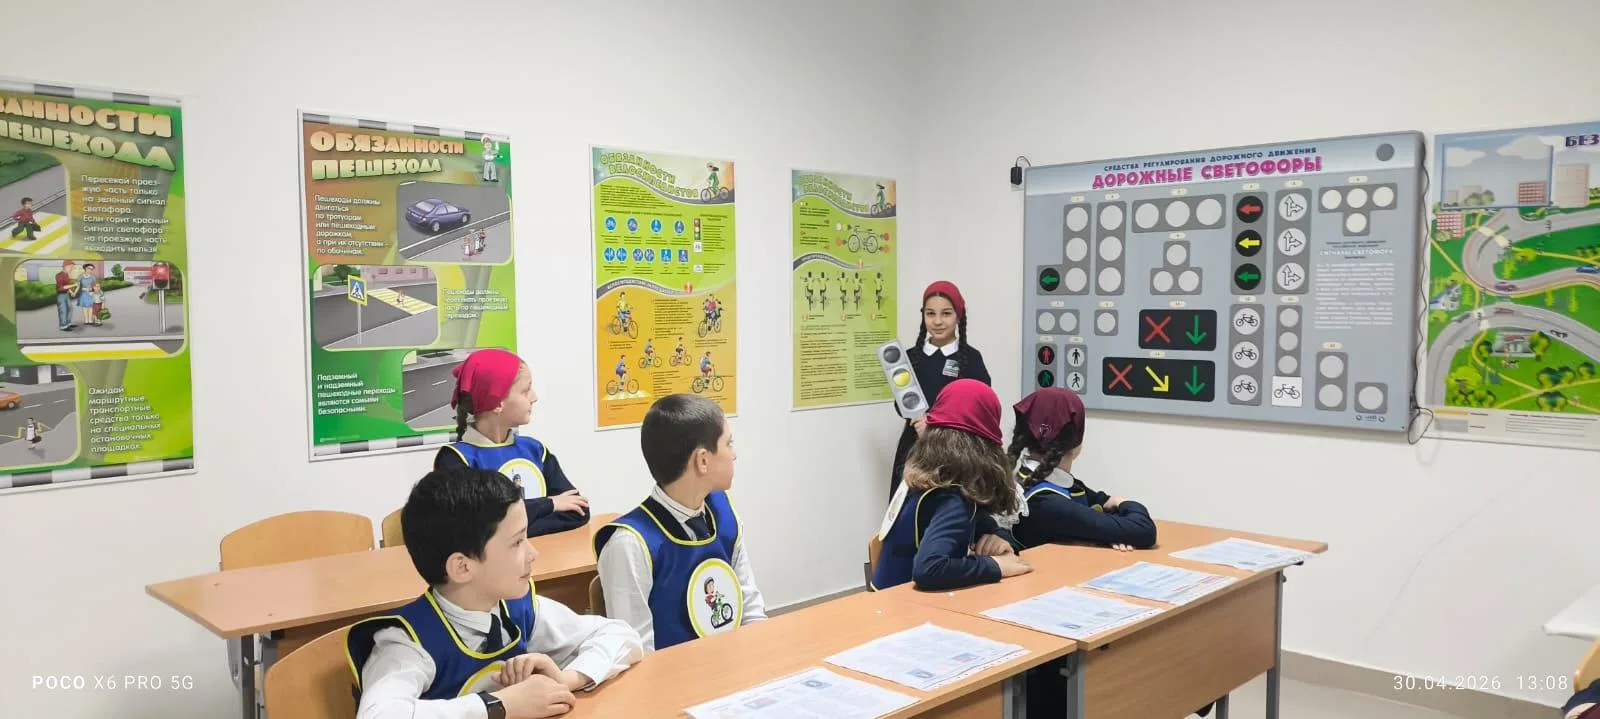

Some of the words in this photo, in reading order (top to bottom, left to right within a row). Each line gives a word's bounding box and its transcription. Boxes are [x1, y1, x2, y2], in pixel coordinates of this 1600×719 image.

[310, 131, 464, 154] ОБЯЗАННОСТИ
[1565, 134, 1600, 147] БЕЗ
[1104, 163, 1139, 171] СРЕДСТВА
[1143, 157, 1206, 168] РЕГУЛИРОВАНИЯ
[1210, 151, 1263, 162] ДОРОЖНОГО
[1268, 147, 1317, 157] ДВИЖЕНИЯ
[312, 158, 442, 180] ПЕШЕХОДА
[1092, 167, 1192, 189] ДОРОЖНЫЕ
[1201, 156, 1322, 180] СВЕТОФОРЫ
[82, 175, 130, 186] Пересекай
[130, 187, 158, 196] только
[137, 198, 166, 206] сигнал
[315, 194, 352, 204] Пешеходы
[133, 215, 169, 224] красный
[116, 225, 163, 235] светофора
[98, 235, 142, 244] проезжую
[317, 373, 358, 381] Подземный
[89, 386, 124, 394] Ожидай
[324, 380, 364, 390] надземный
[363, 388, 396, 396] переходы
[89, 396, 145, 404] маршрутные
[89, 405, 151, 415] транспортные
[89, 415, 129, 425] средства
[104, 424, 160, 432] специальных
[91, 434, 151, 443] остановочных
